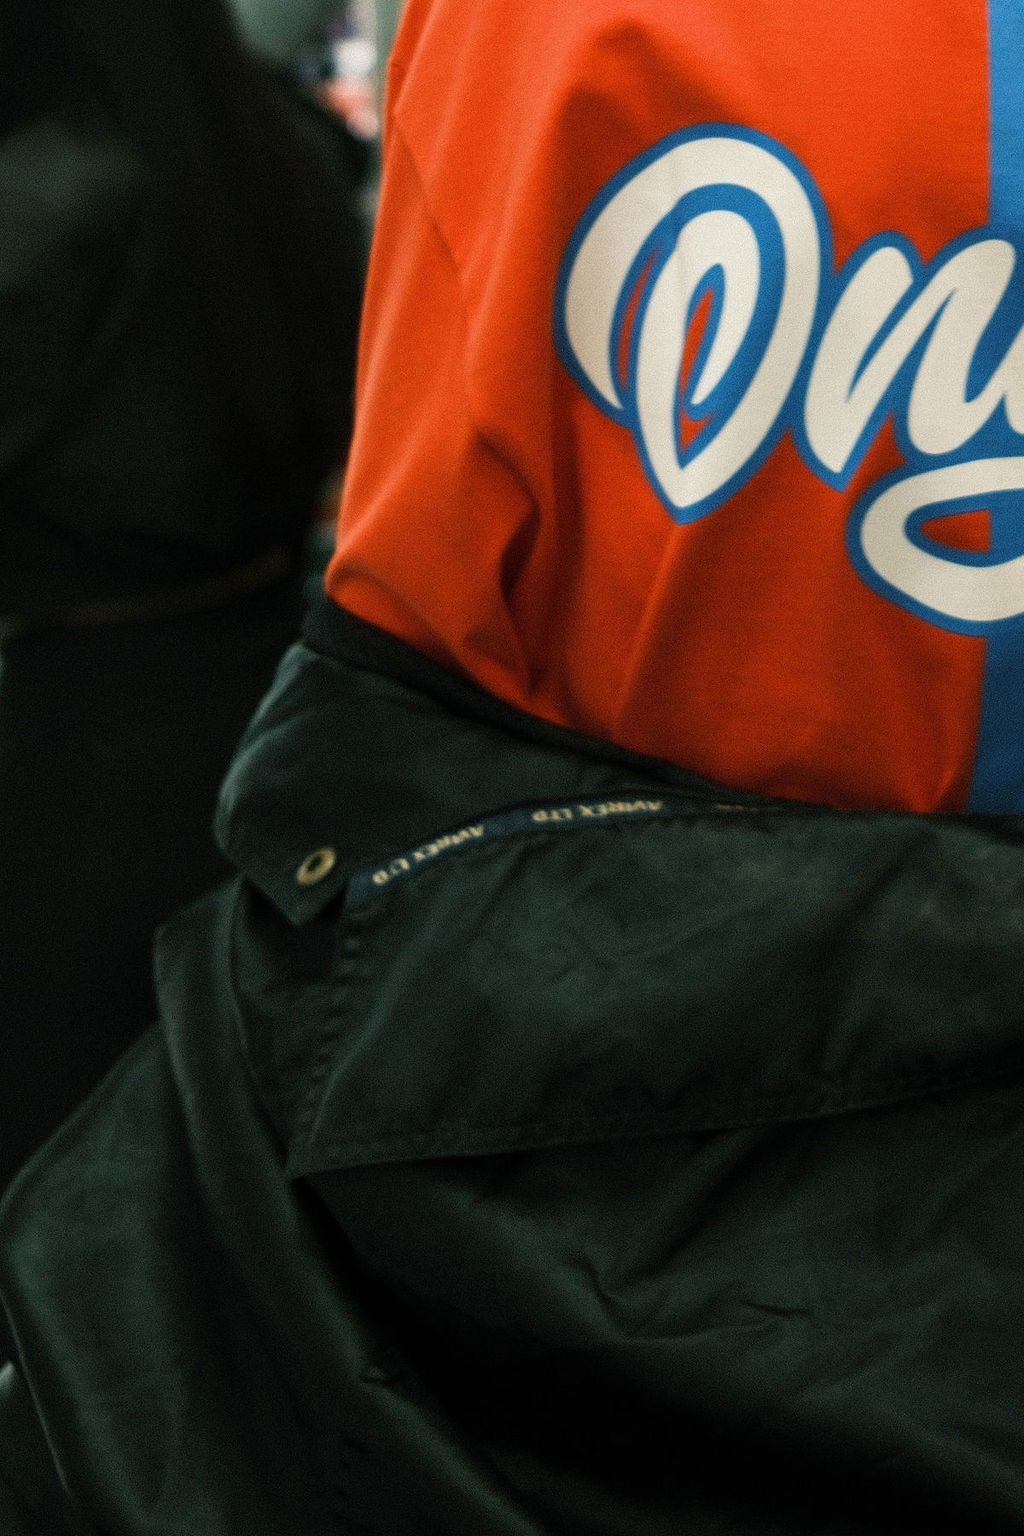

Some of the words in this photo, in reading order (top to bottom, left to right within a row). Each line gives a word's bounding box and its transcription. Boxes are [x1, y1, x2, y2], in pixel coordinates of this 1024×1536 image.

[532, 808, 574, 823] LTD
[577, 800, 663, 817] AVIREX
[412, 824, 485, 863] AVIREX
[372, 858, 411, 886] LTD
